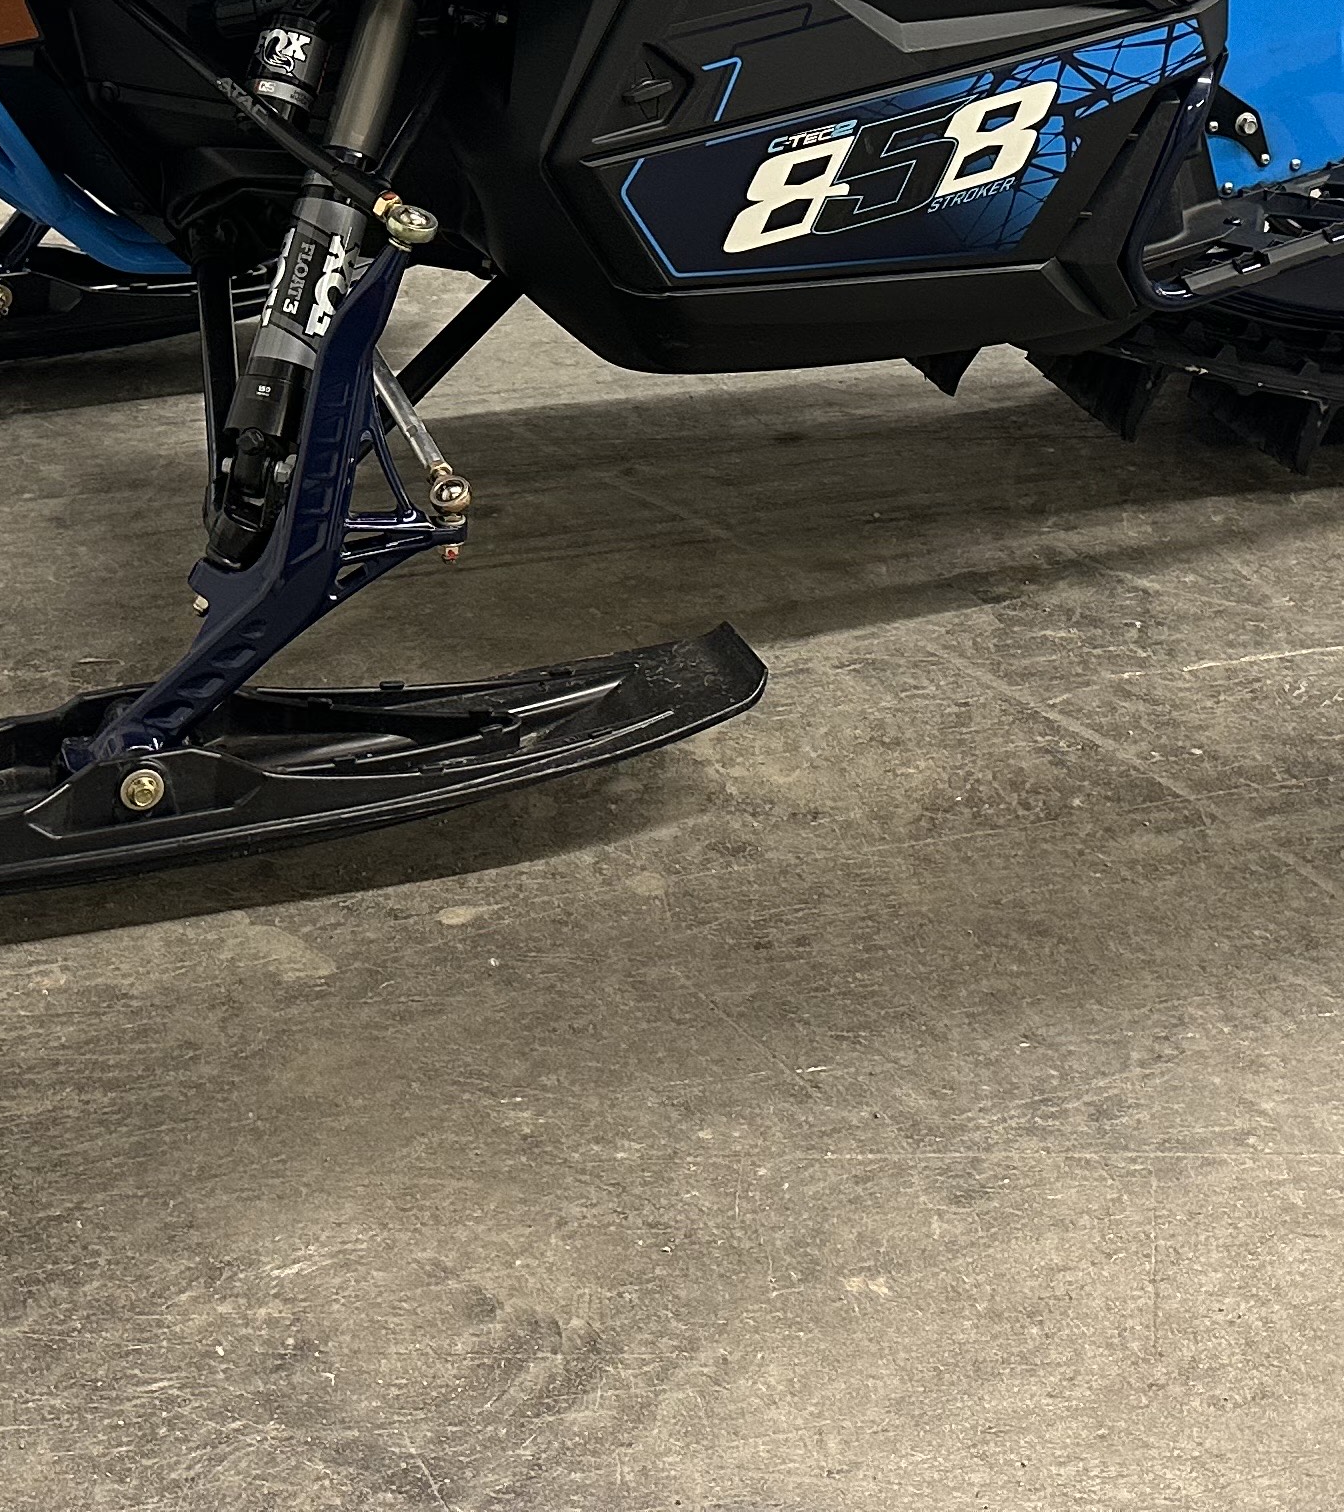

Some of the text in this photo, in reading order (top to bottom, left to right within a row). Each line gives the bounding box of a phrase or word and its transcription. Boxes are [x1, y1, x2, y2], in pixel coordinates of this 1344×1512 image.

[767, 119, 858, 154] C-TEC2
[722, 81, 1058, 254] 858
[927, 177, 1017, 213] STROKER
[287, 241, 316, 301] FLOAT
